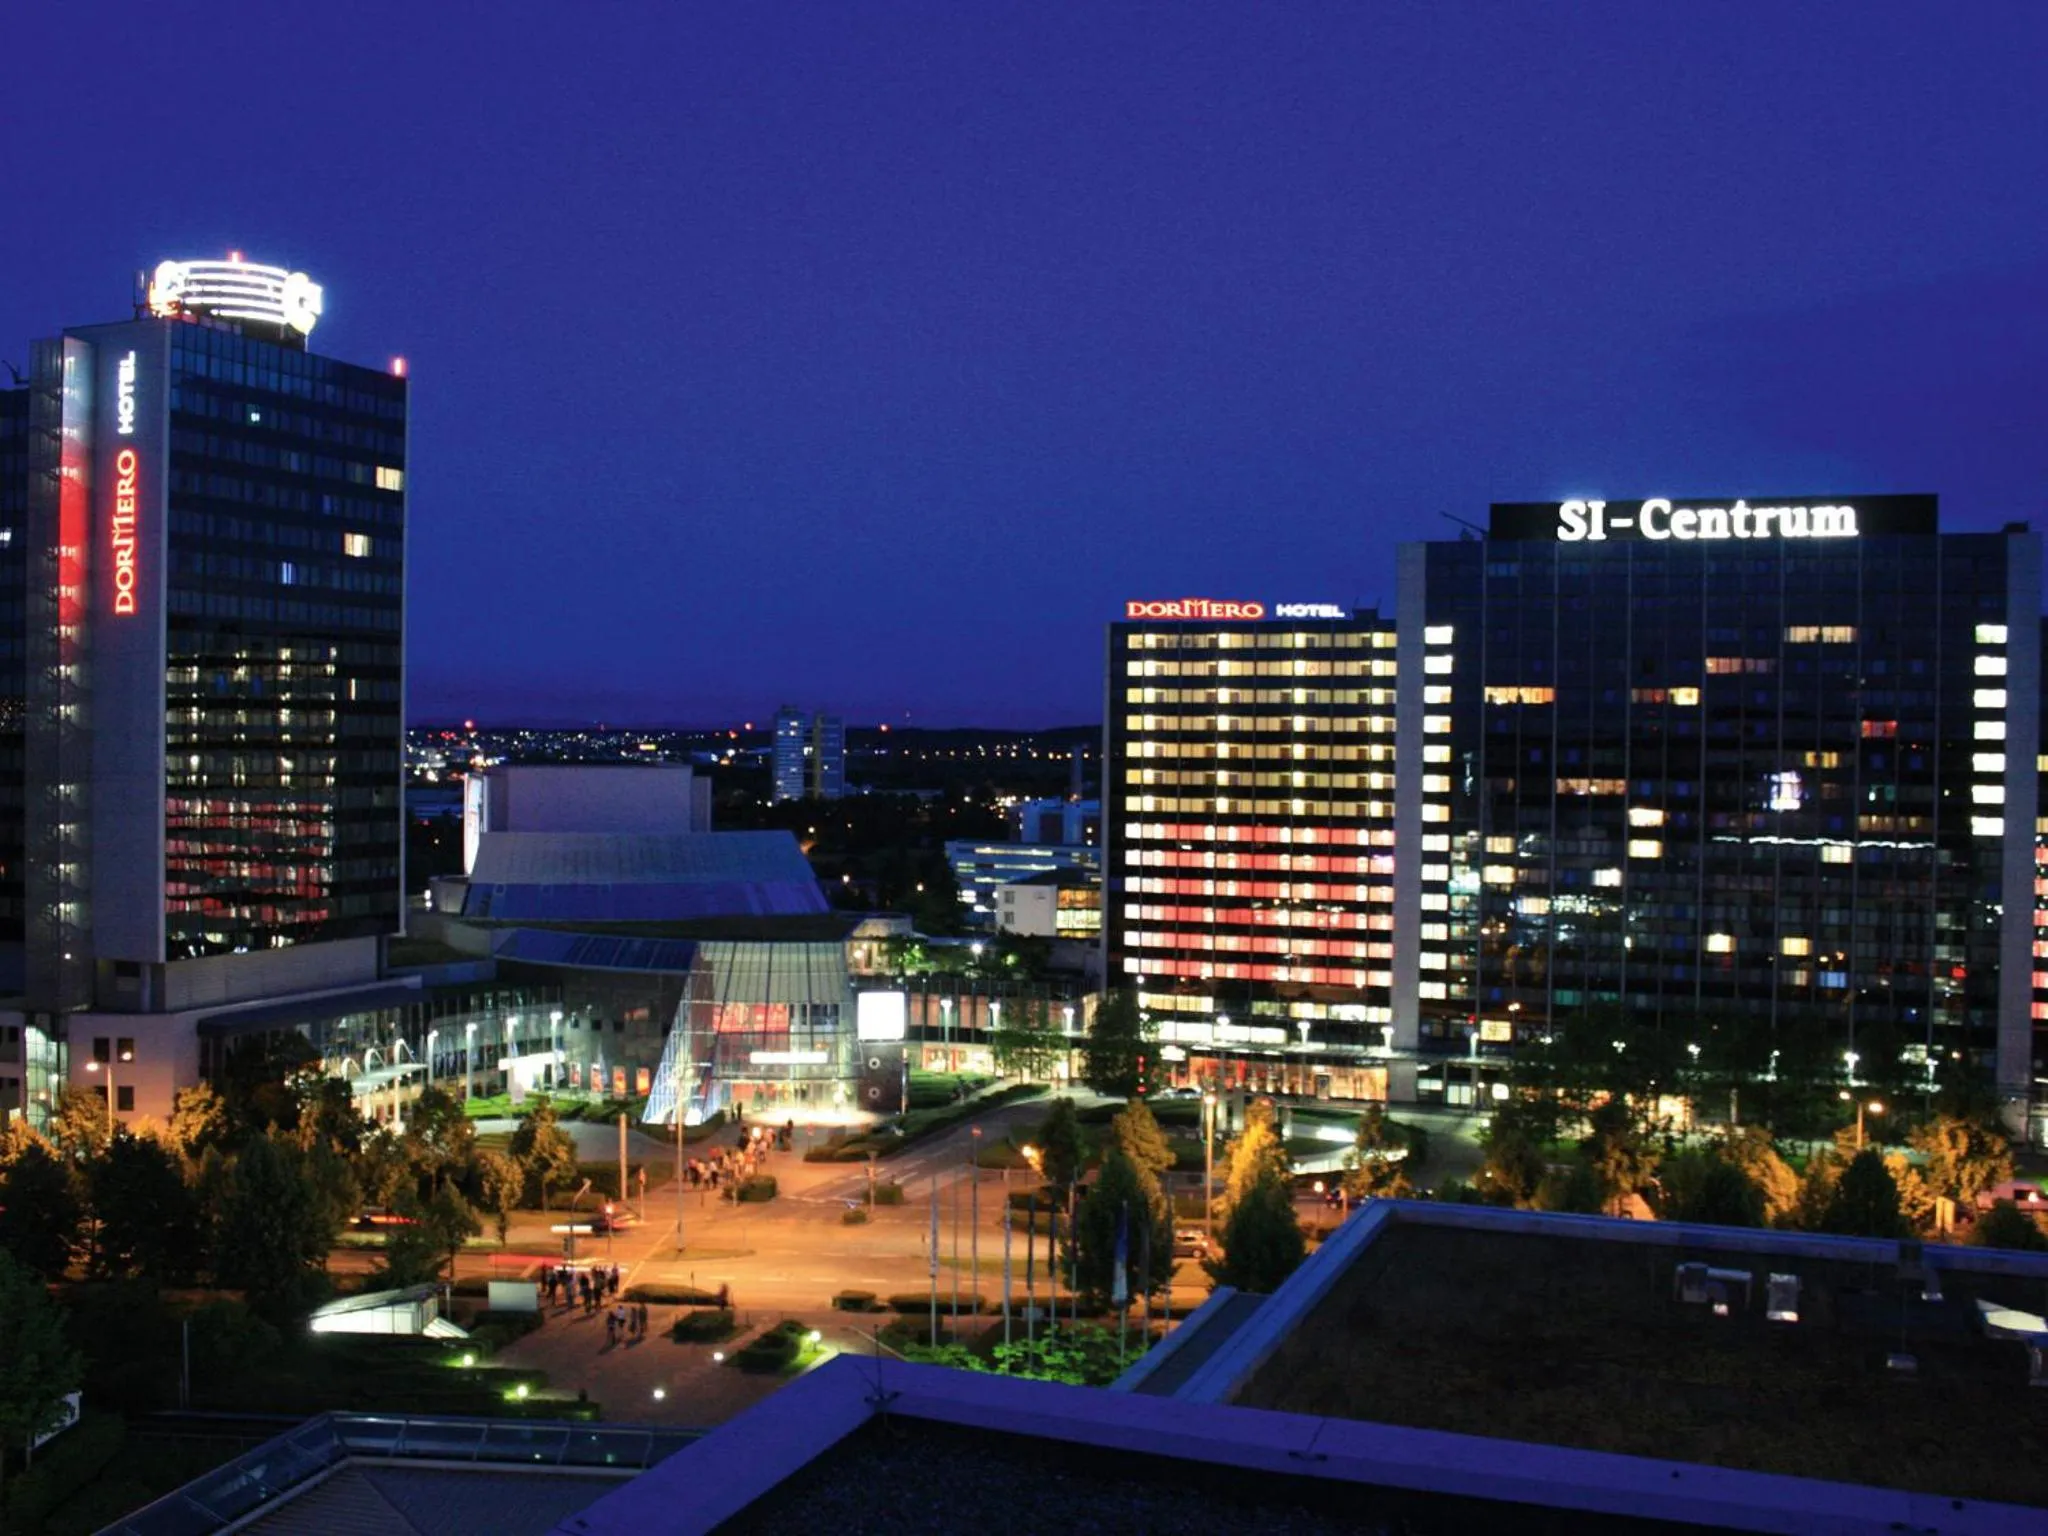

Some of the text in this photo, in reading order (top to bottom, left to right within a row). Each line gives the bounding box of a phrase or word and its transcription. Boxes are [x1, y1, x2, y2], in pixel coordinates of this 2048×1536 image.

[118, 350, 136, 434] HOTEL
[1557, 498, 1859, 541] SI-Centrum
[1275, 603, 1345, 617] HOTEL
